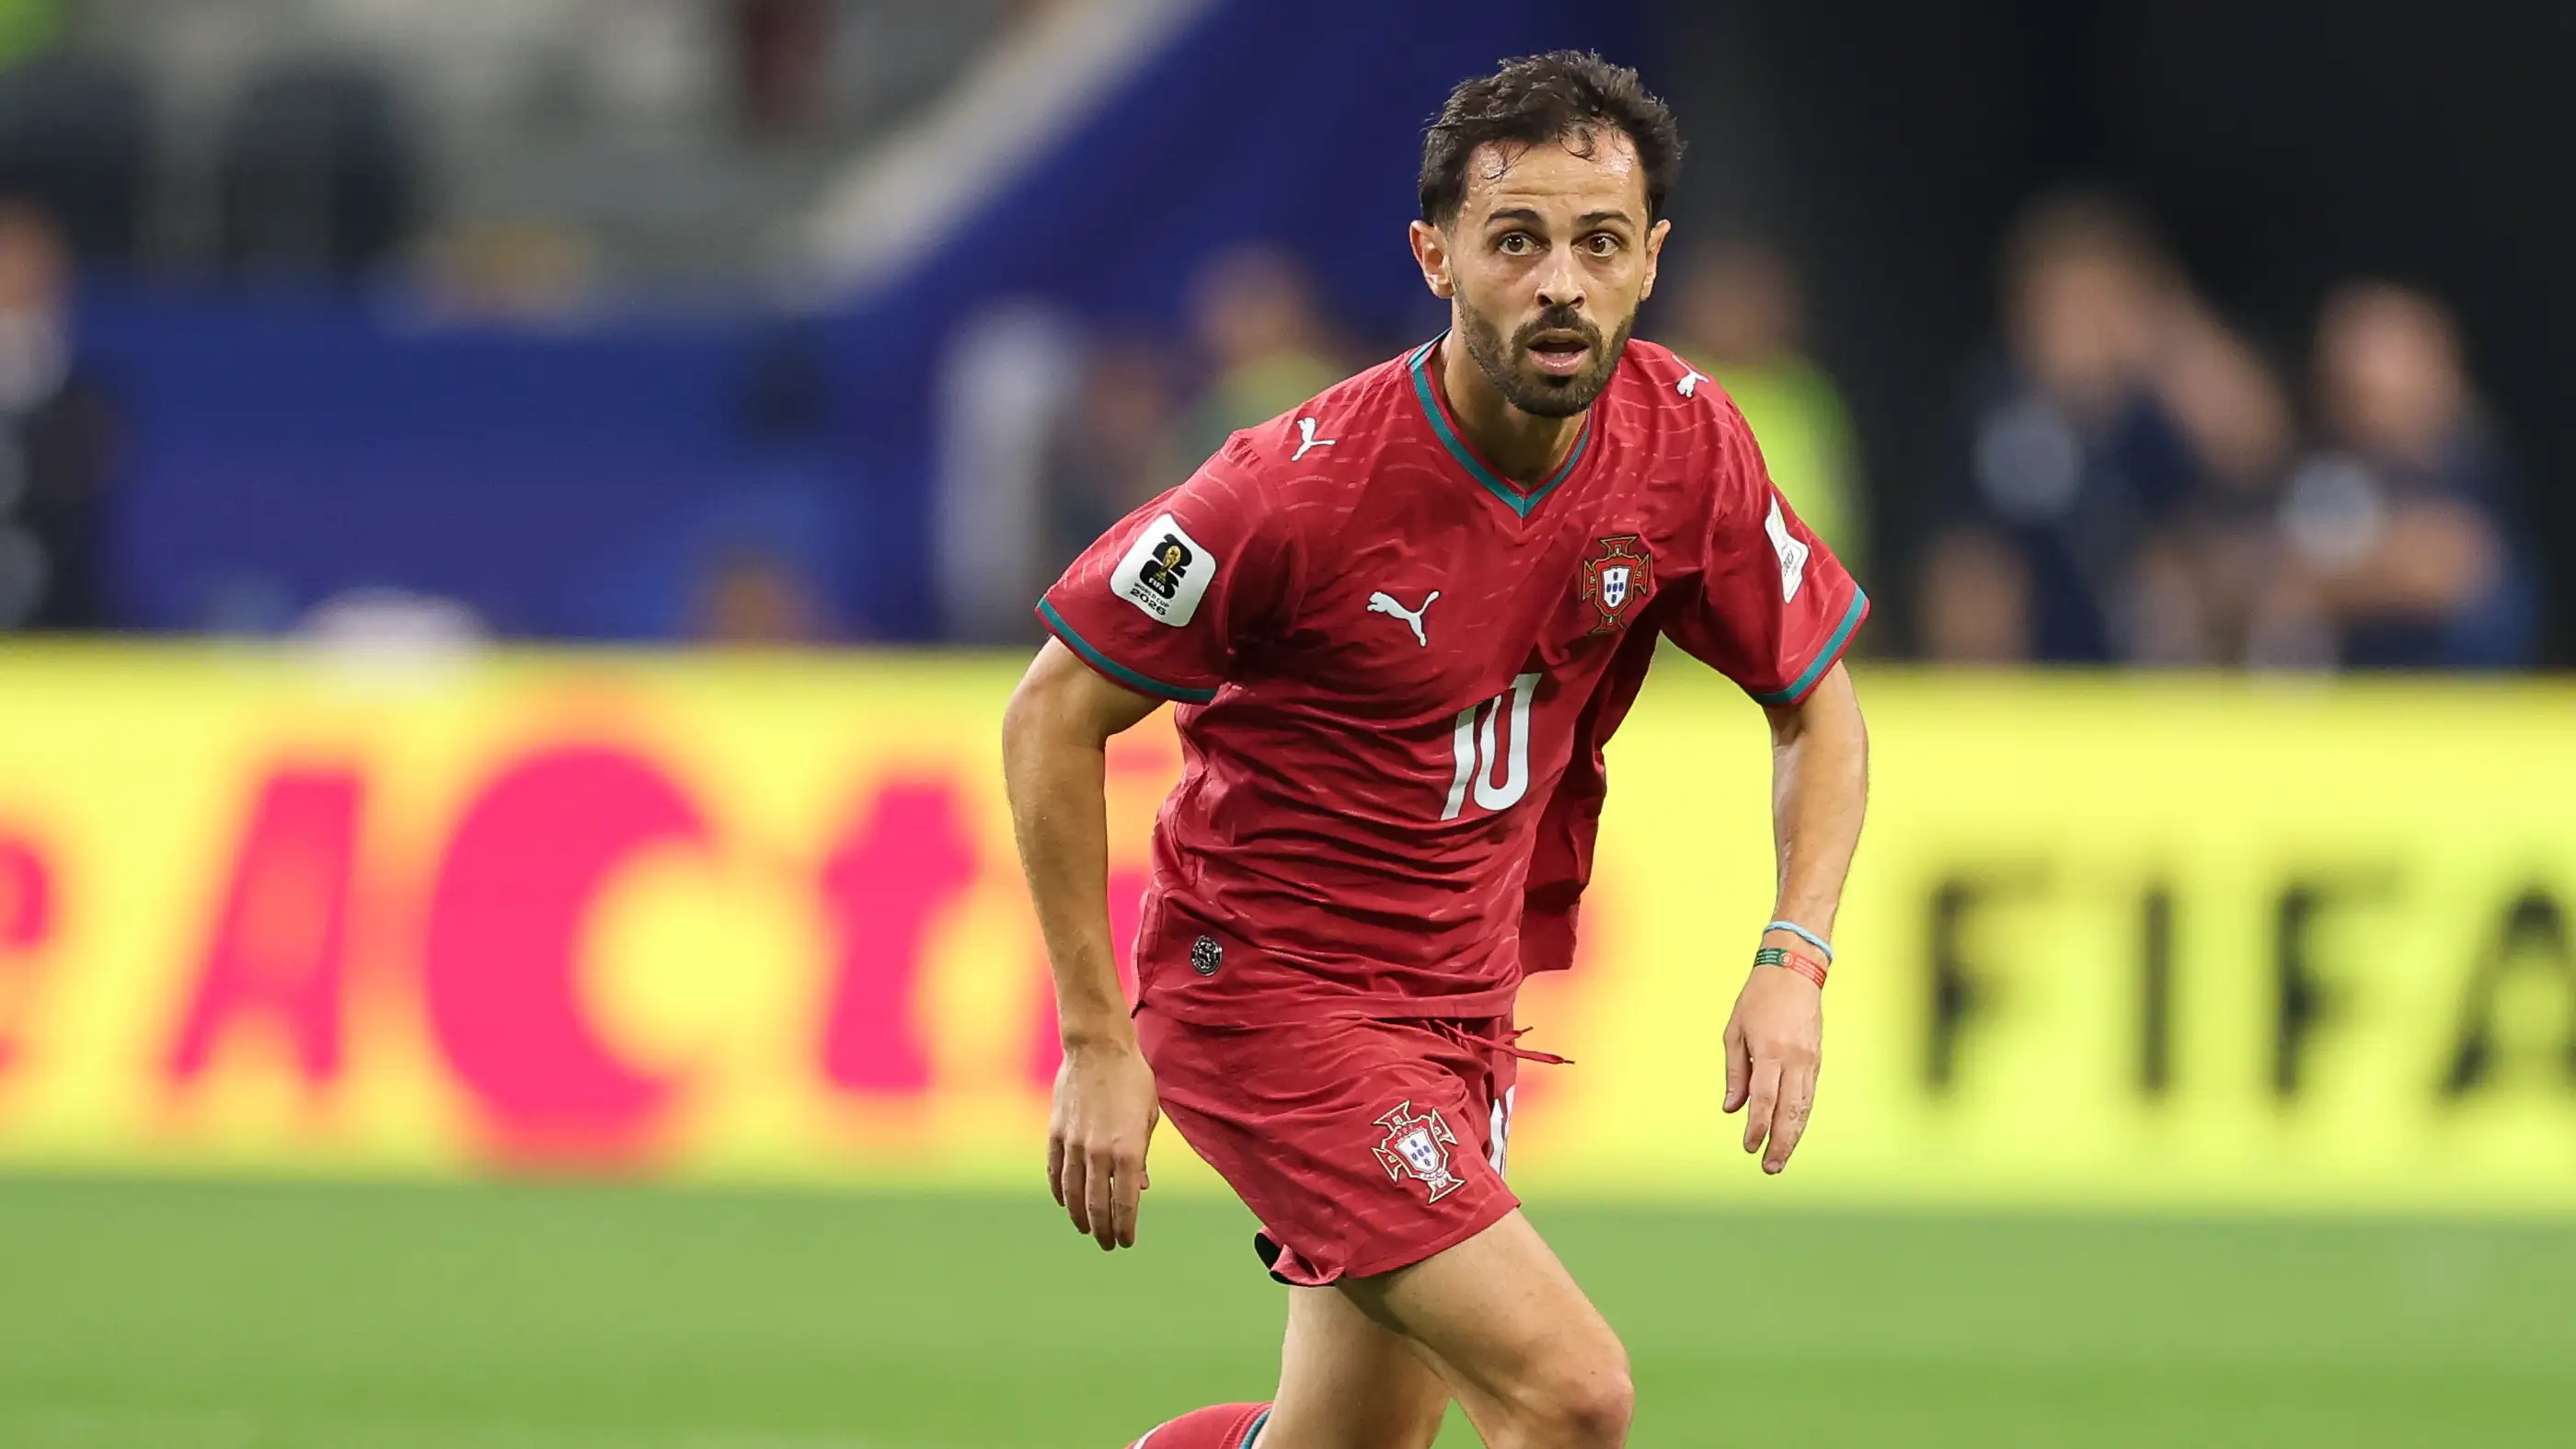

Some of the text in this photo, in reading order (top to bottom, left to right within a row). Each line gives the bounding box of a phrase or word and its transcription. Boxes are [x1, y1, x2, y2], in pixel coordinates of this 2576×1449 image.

[1133, 582, 1170, 608] WORLD CUP
[1148, 577, 1166, 593] FIFA
[1130, 588, 1167, 615] 2026
[1440, 673, 1543, 822] 10
[1918, 860, 2576, 1099] FIFA
